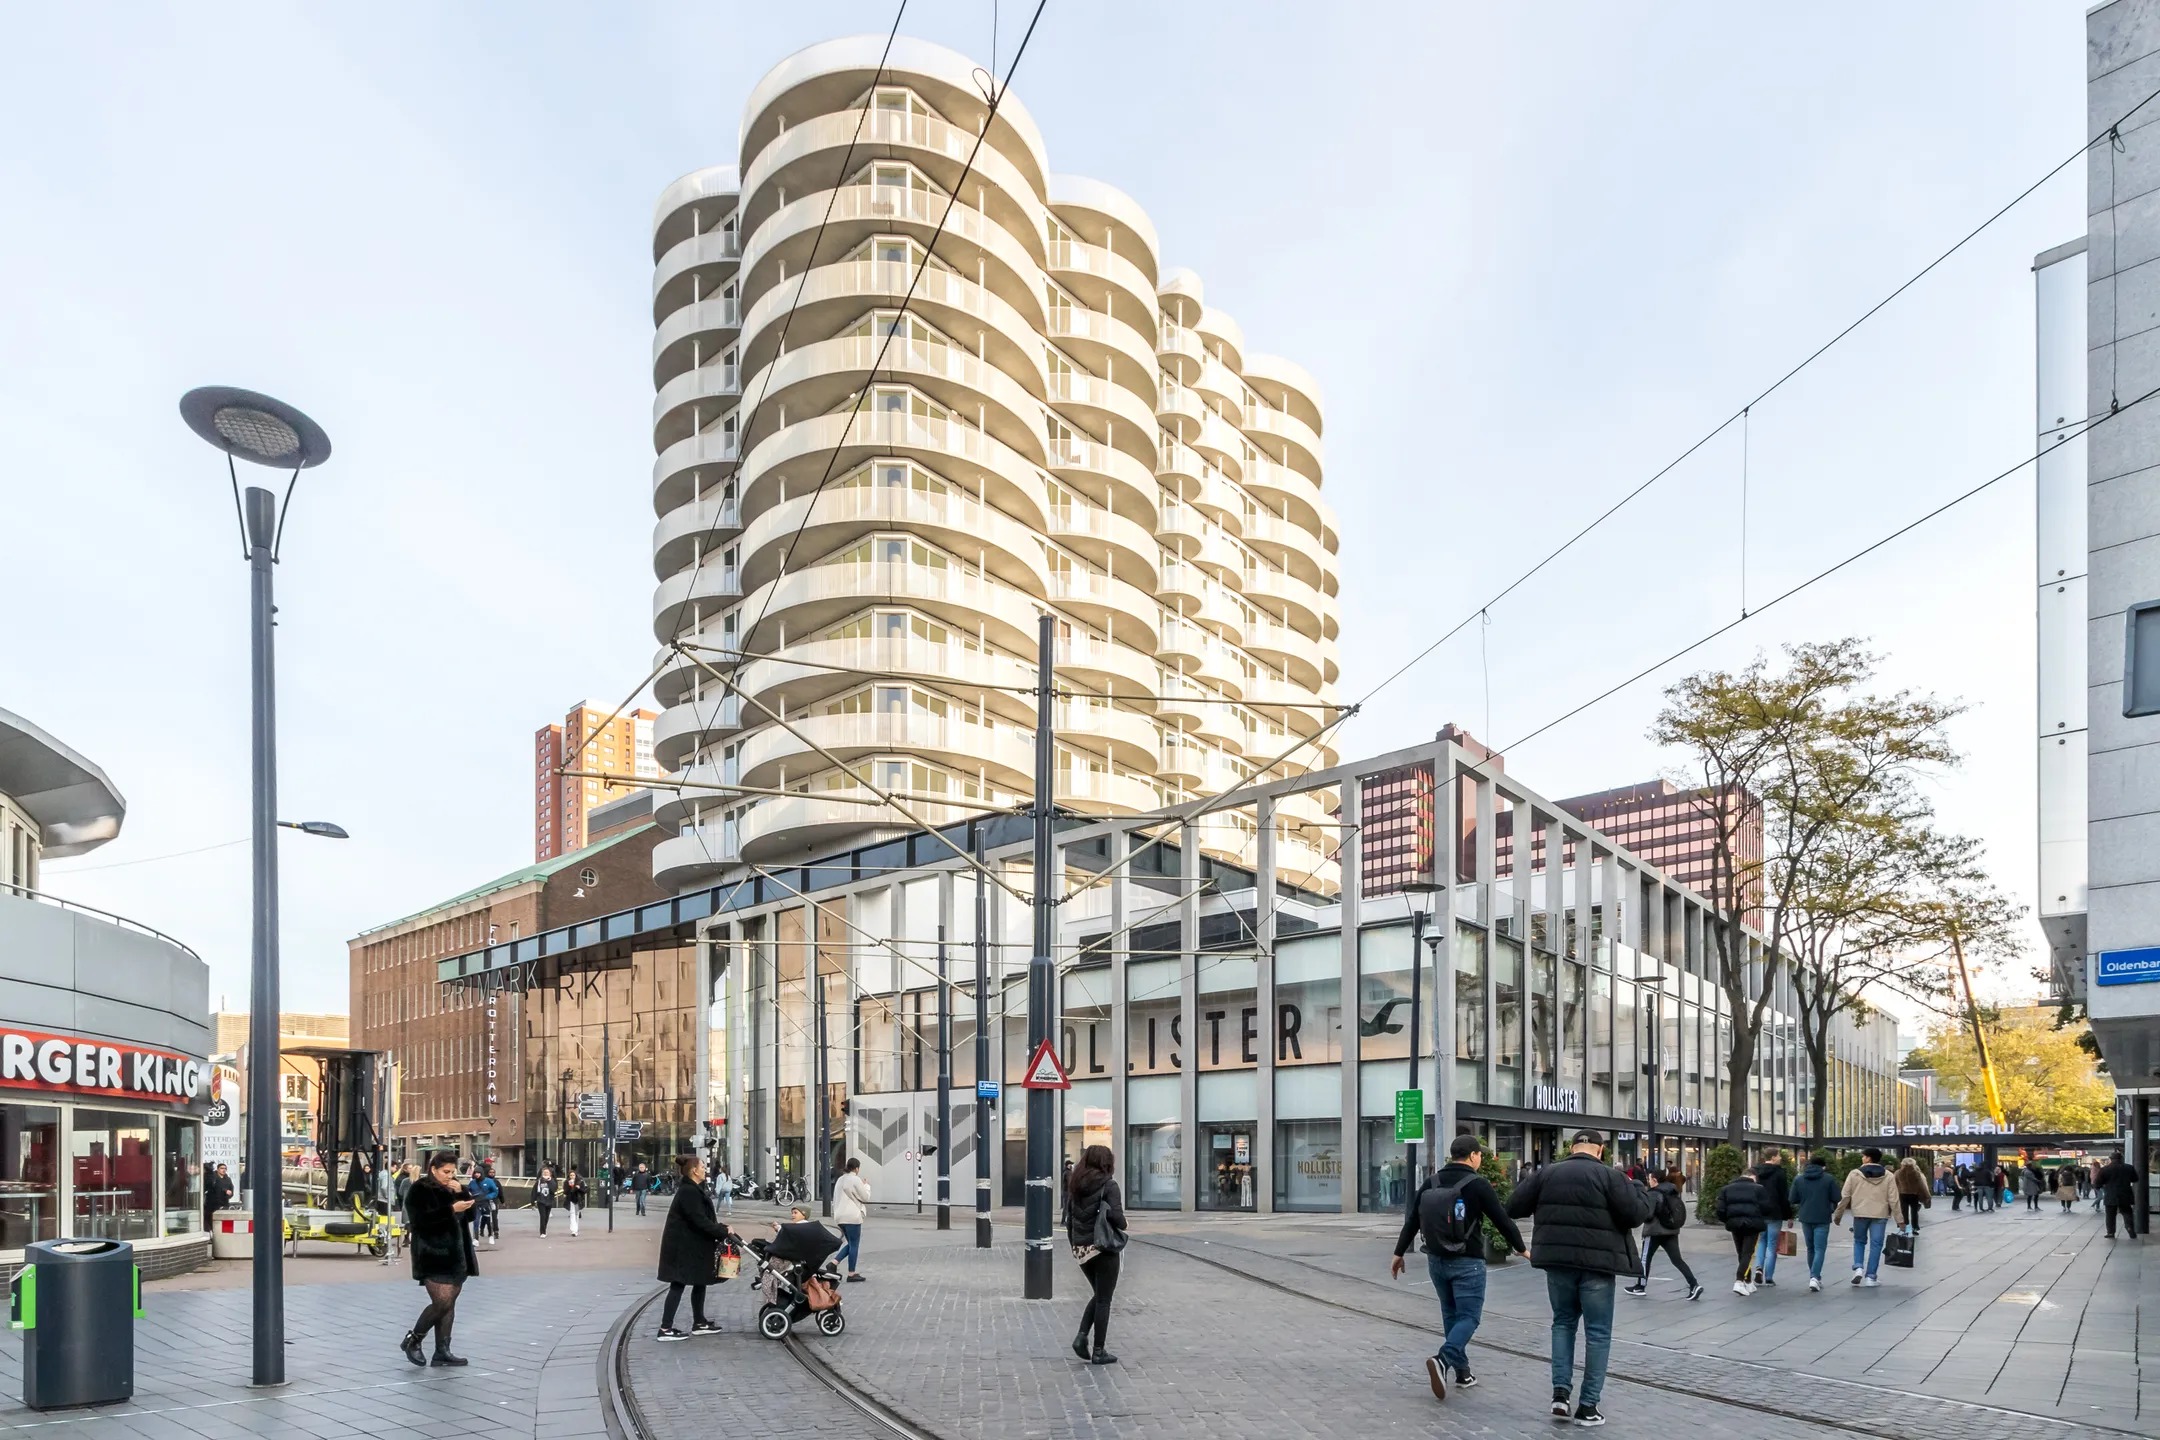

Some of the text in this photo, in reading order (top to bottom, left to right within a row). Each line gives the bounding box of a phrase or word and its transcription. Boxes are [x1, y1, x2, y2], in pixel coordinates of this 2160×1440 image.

[441, 961, 538, 1009] PRIMARK
[487, 996, 498, 1103] ROTTERDAM
[133, 1051, 200, 1098] KING
[1536, 1085, 1579, 1113] HOLLISTER
[1666, 1104, 1702, 1125] COSTES
[1881, 1123, 2015, 1136] G-STAR RAW
[1150, 1162, 1181, 1174] HOLLIST
[1297, 1160, 1342, 1174] HOLLISTE
